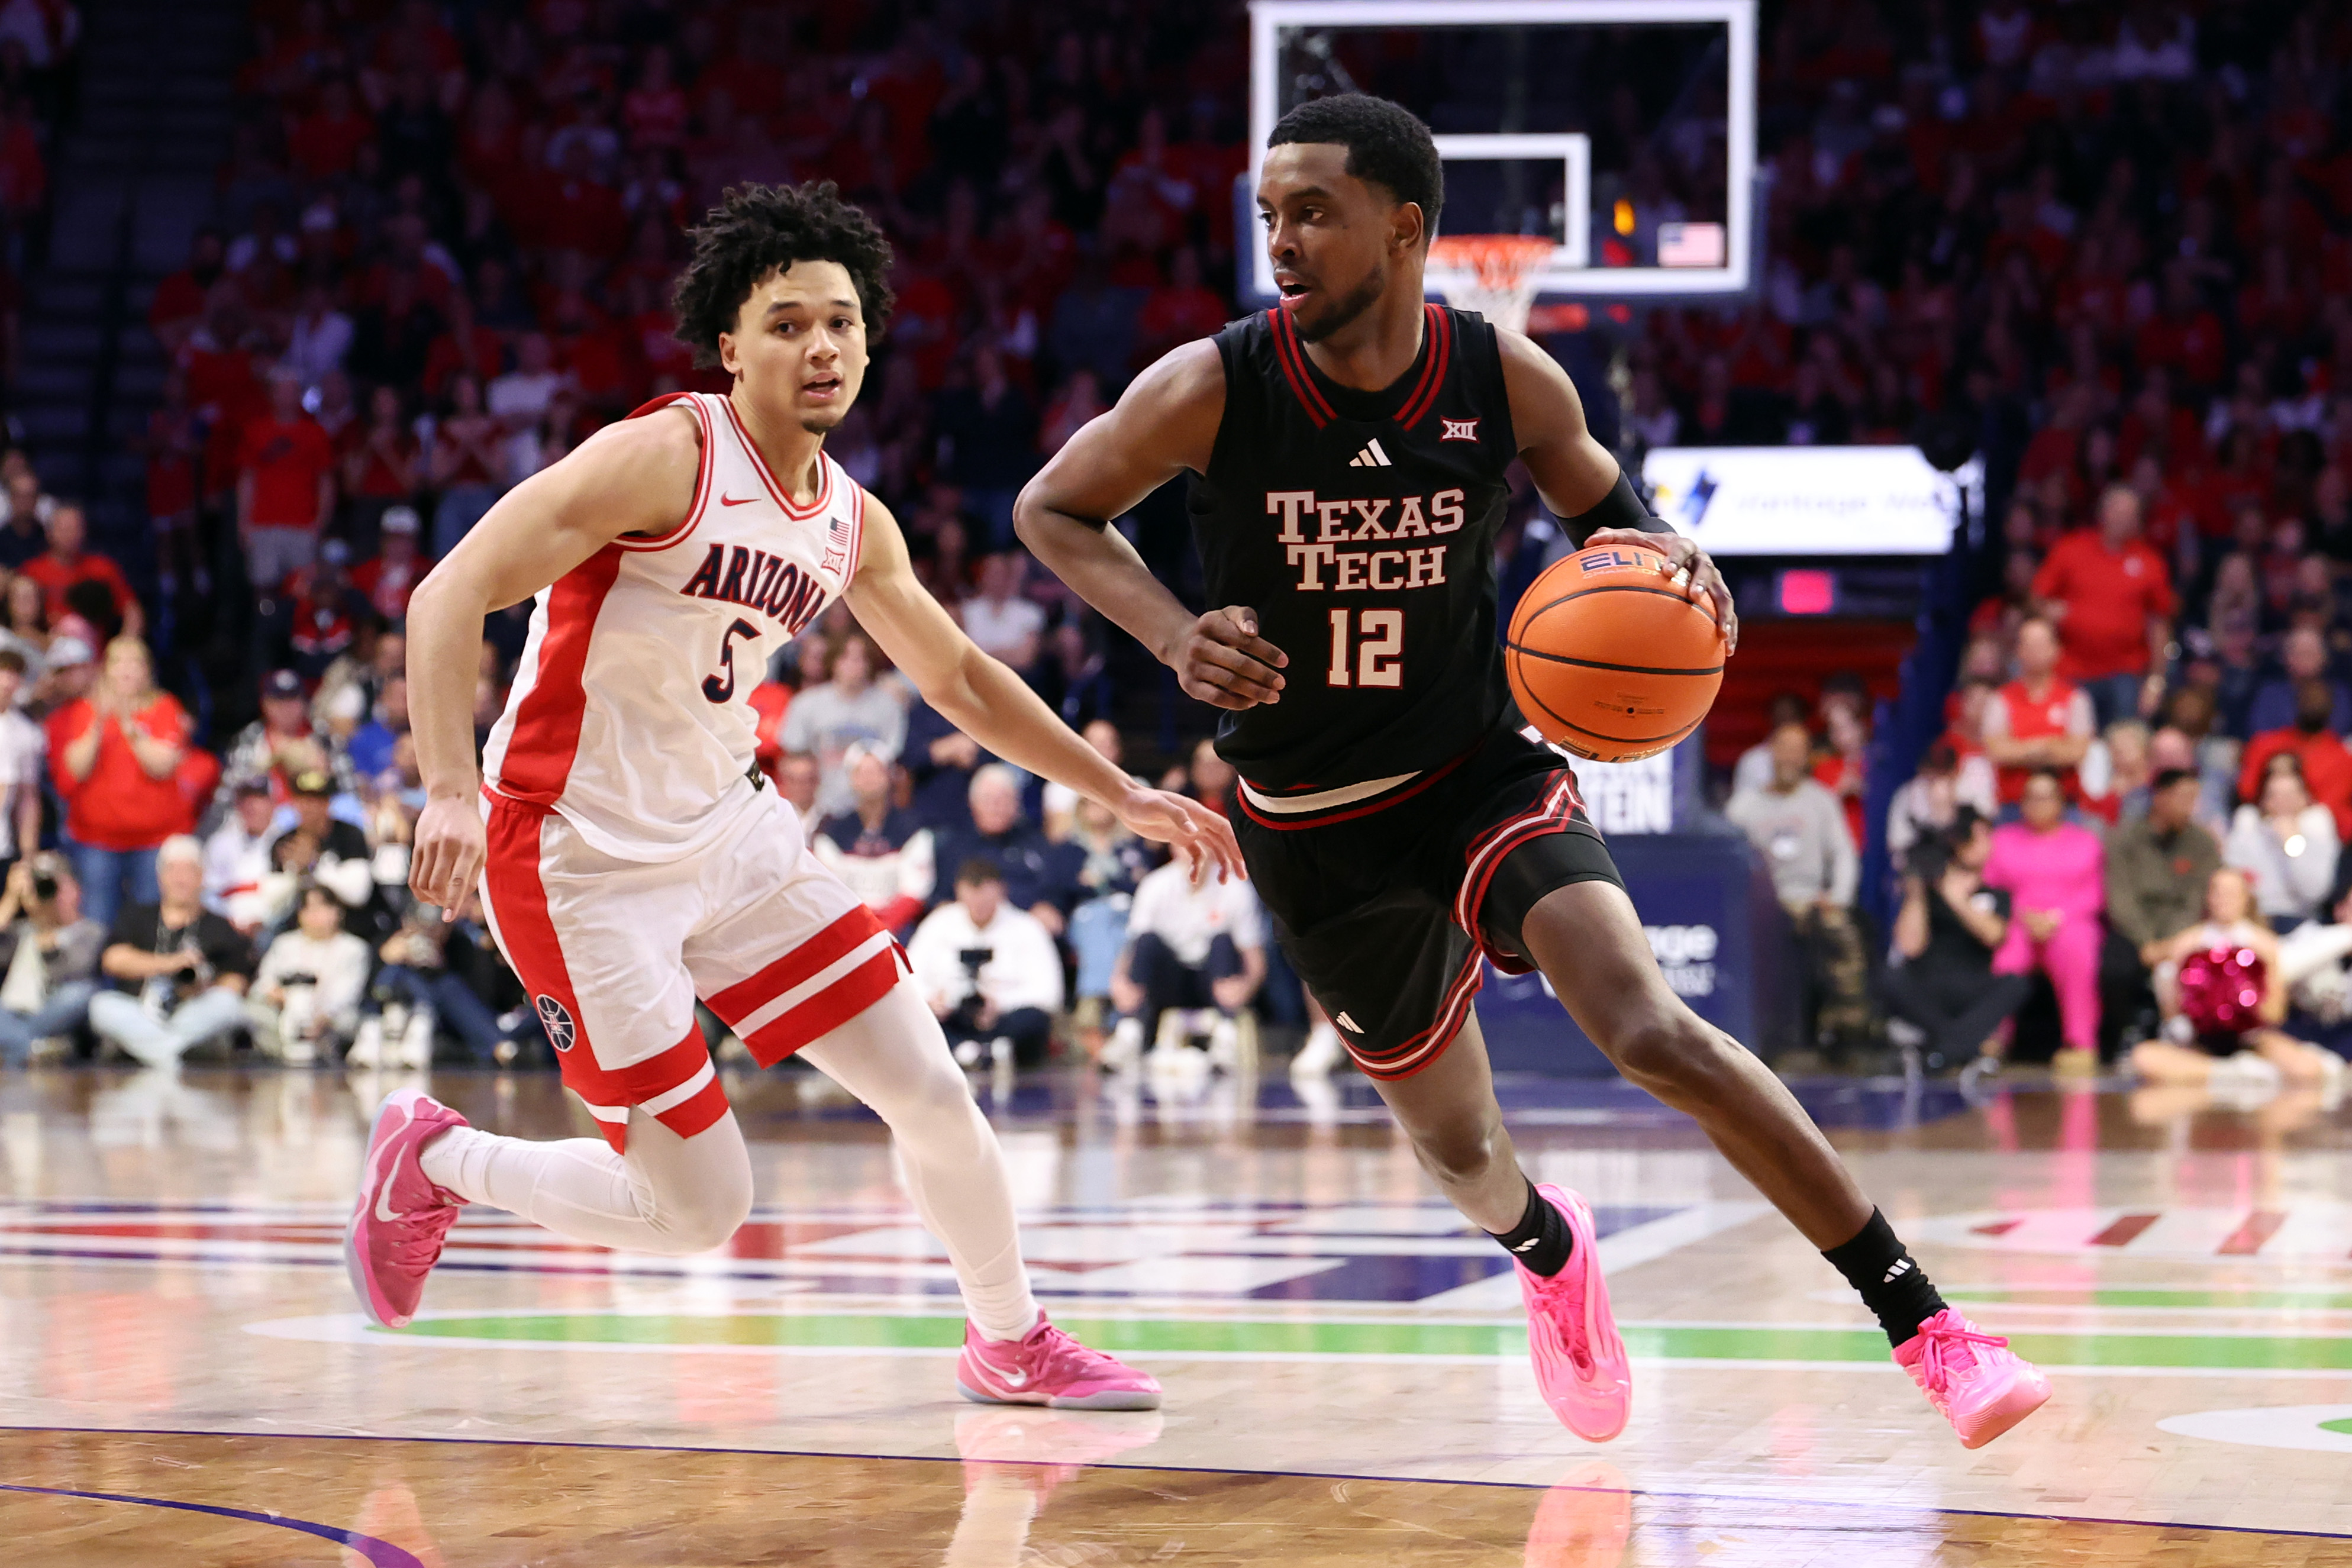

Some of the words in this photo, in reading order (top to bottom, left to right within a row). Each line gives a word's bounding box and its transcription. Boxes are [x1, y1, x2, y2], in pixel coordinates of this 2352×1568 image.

[1264, 486, 1466, 544] TEXAS
[1286, 542, 1447, 592] TECH
[1579, 551, 1664, 572] ELIT
[701, 616, 762, 704] 5
[1326, 608, 1406, 689] 12
